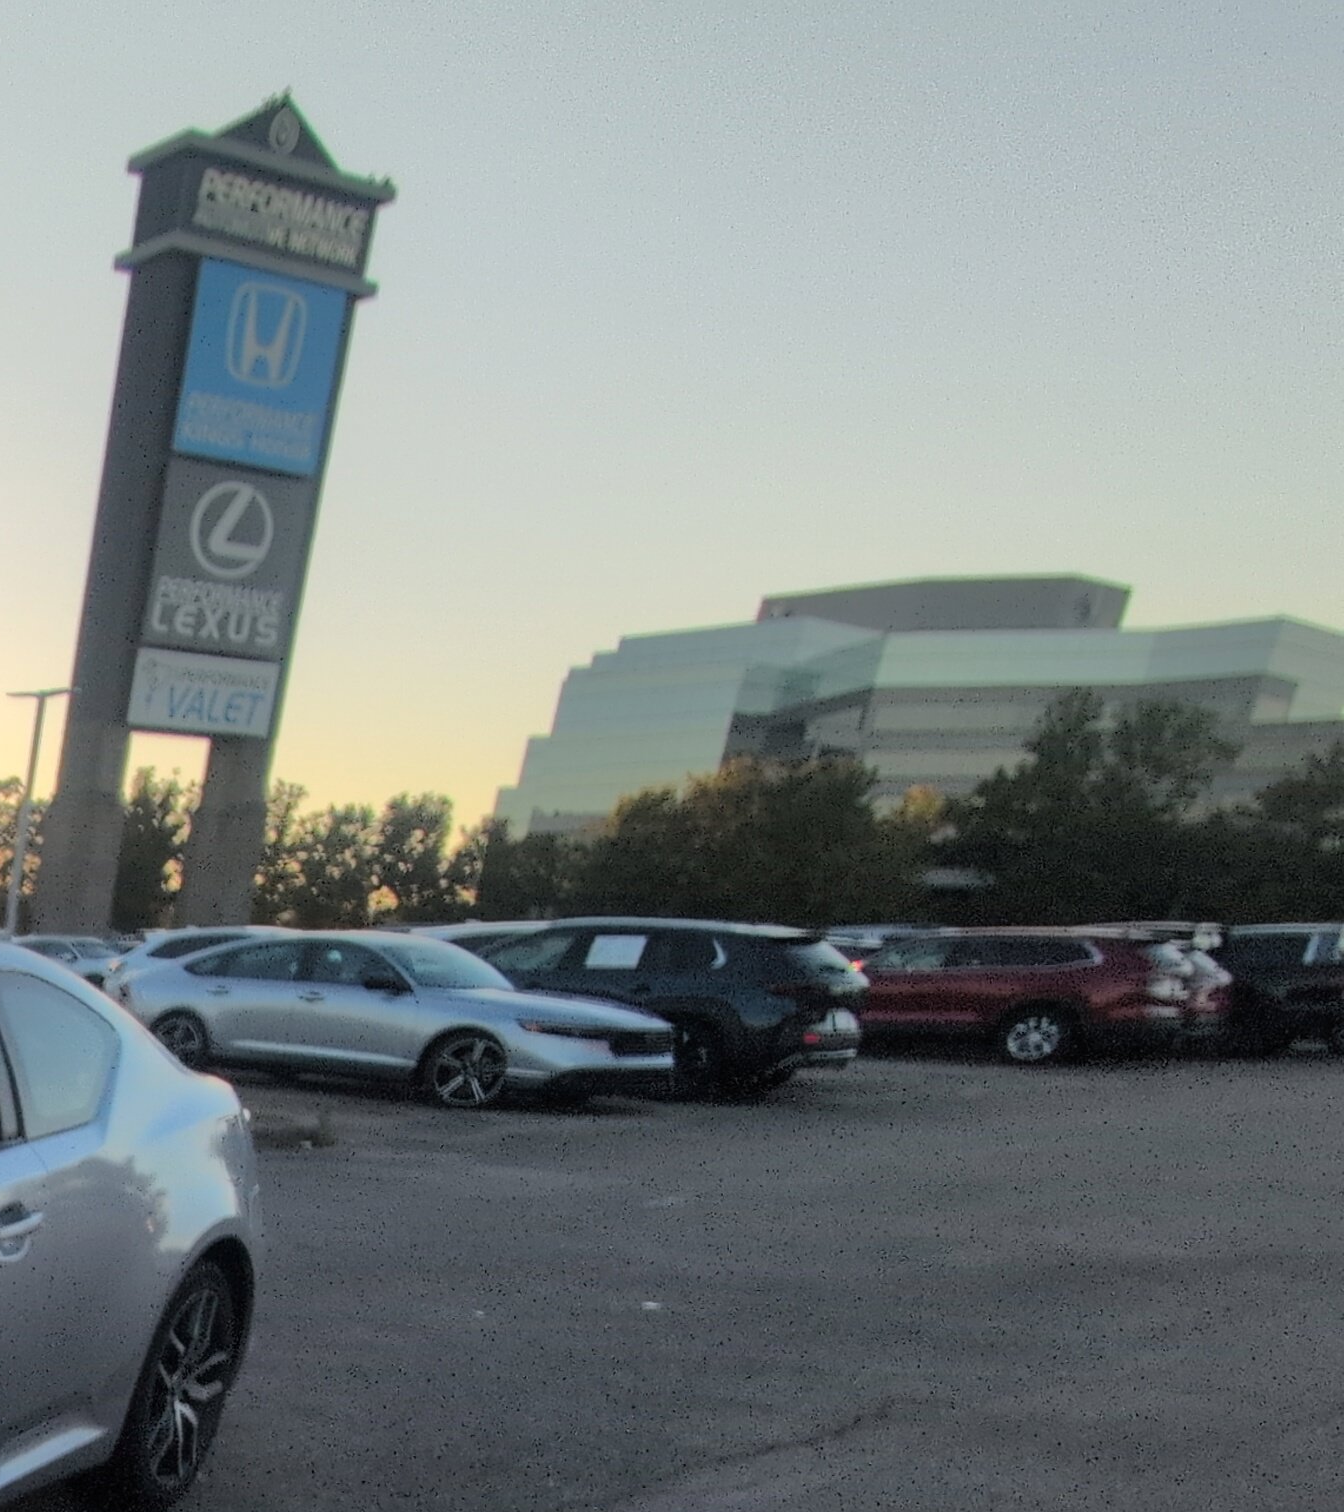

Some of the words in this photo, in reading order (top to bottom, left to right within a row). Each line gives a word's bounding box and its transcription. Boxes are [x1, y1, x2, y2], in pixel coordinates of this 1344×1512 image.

[199, 168, 369, 236] PERFORMANCE
[152, 602, 279, 645] LEXUS
[169, 685, 264, 724] VALET
